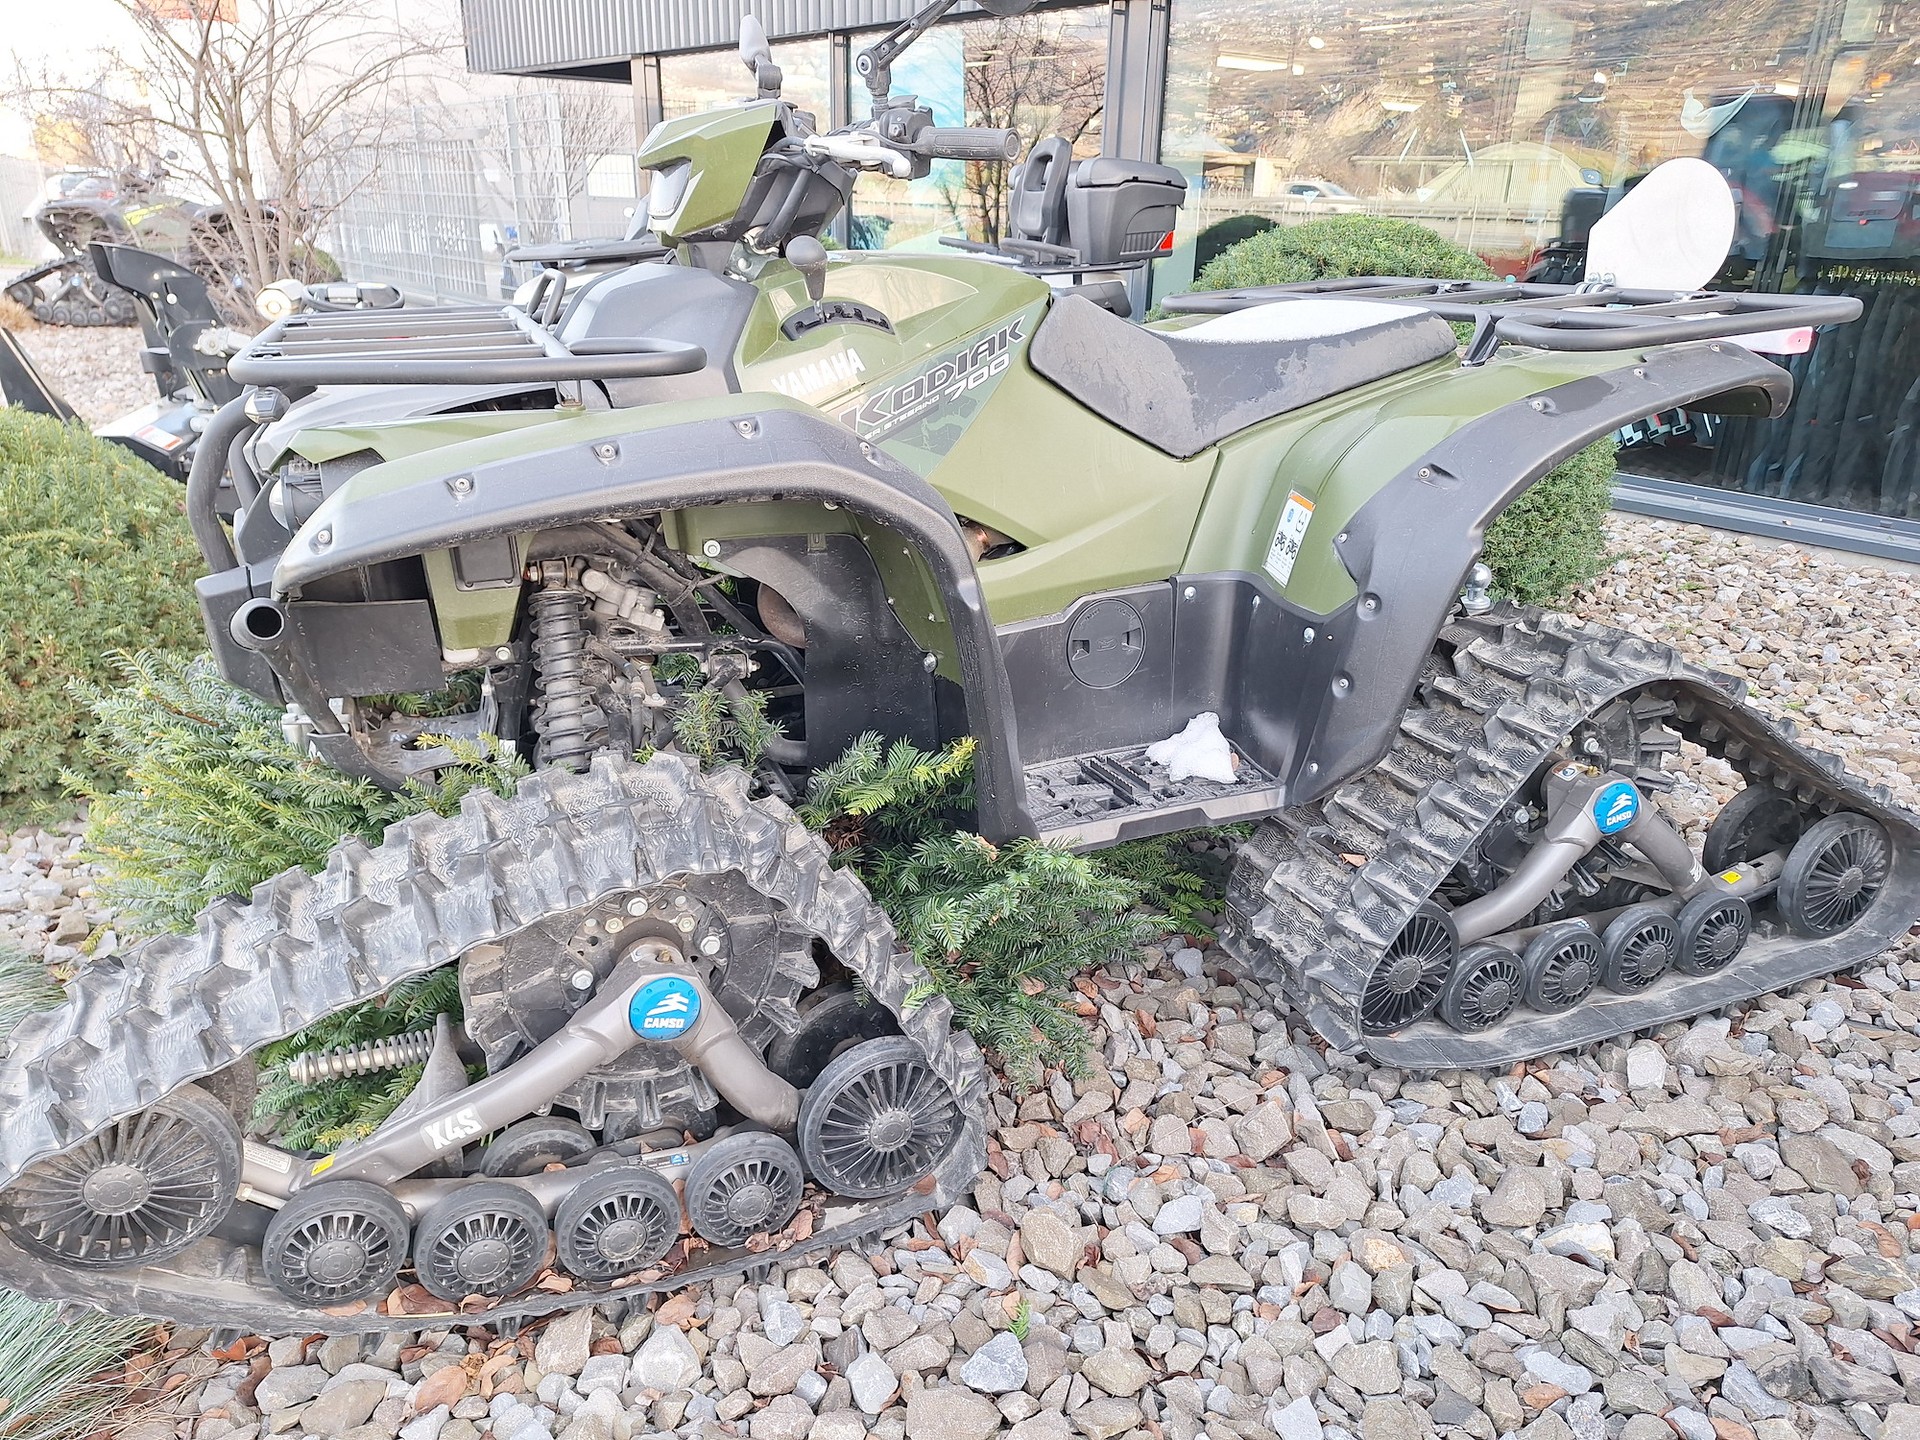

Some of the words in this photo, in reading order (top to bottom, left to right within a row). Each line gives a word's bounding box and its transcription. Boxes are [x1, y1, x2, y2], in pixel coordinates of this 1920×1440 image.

[770, 347, 867, 398] YAMAHA
[838, 315, 1026, 434] KODIAK
[944, 352, 1010, 403] 700
[883, 395, 940, 430] STEERING
[1606, 810, 1632, 826] CAMSO
[643, 1017, 686, 1029] CAMSO
[423, 1106, 483, 1150] X4S
